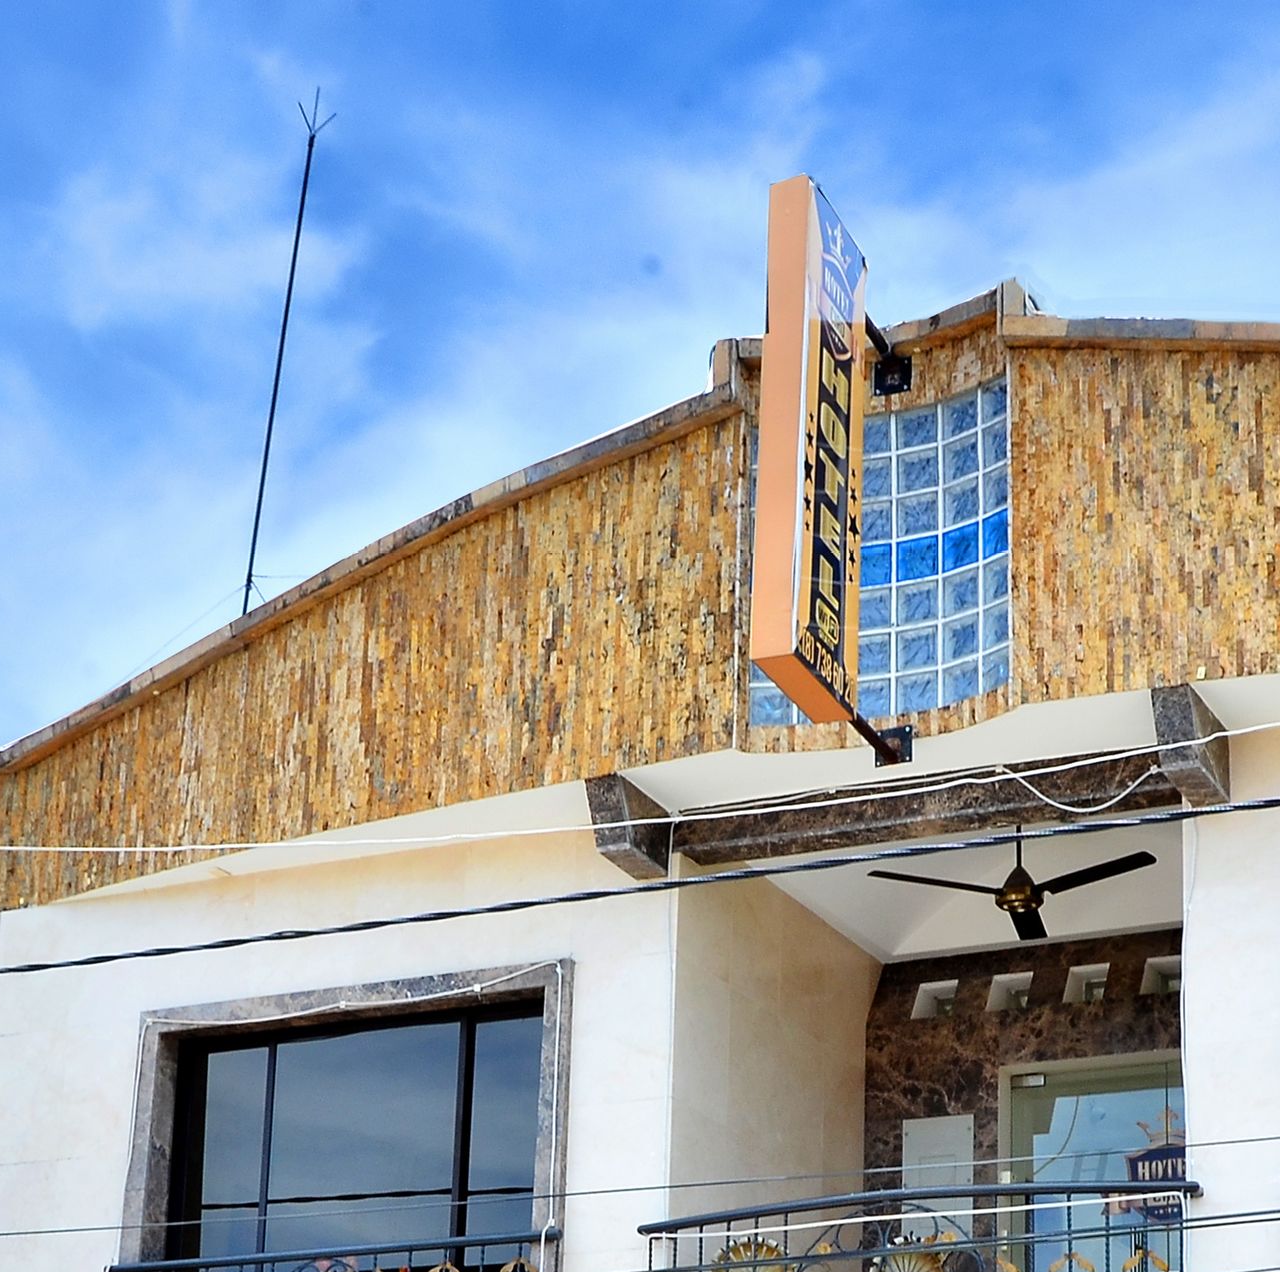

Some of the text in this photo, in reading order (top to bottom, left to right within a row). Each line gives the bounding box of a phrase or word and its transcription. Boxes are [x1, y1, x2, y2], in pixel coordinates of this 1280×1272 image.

[819, 348, 849, 611] HOTEL
[816, 641, 832, 684] 738
[833, 661, 844, 696] 60
[1137, 1158, 1186, 1181] HOTE
